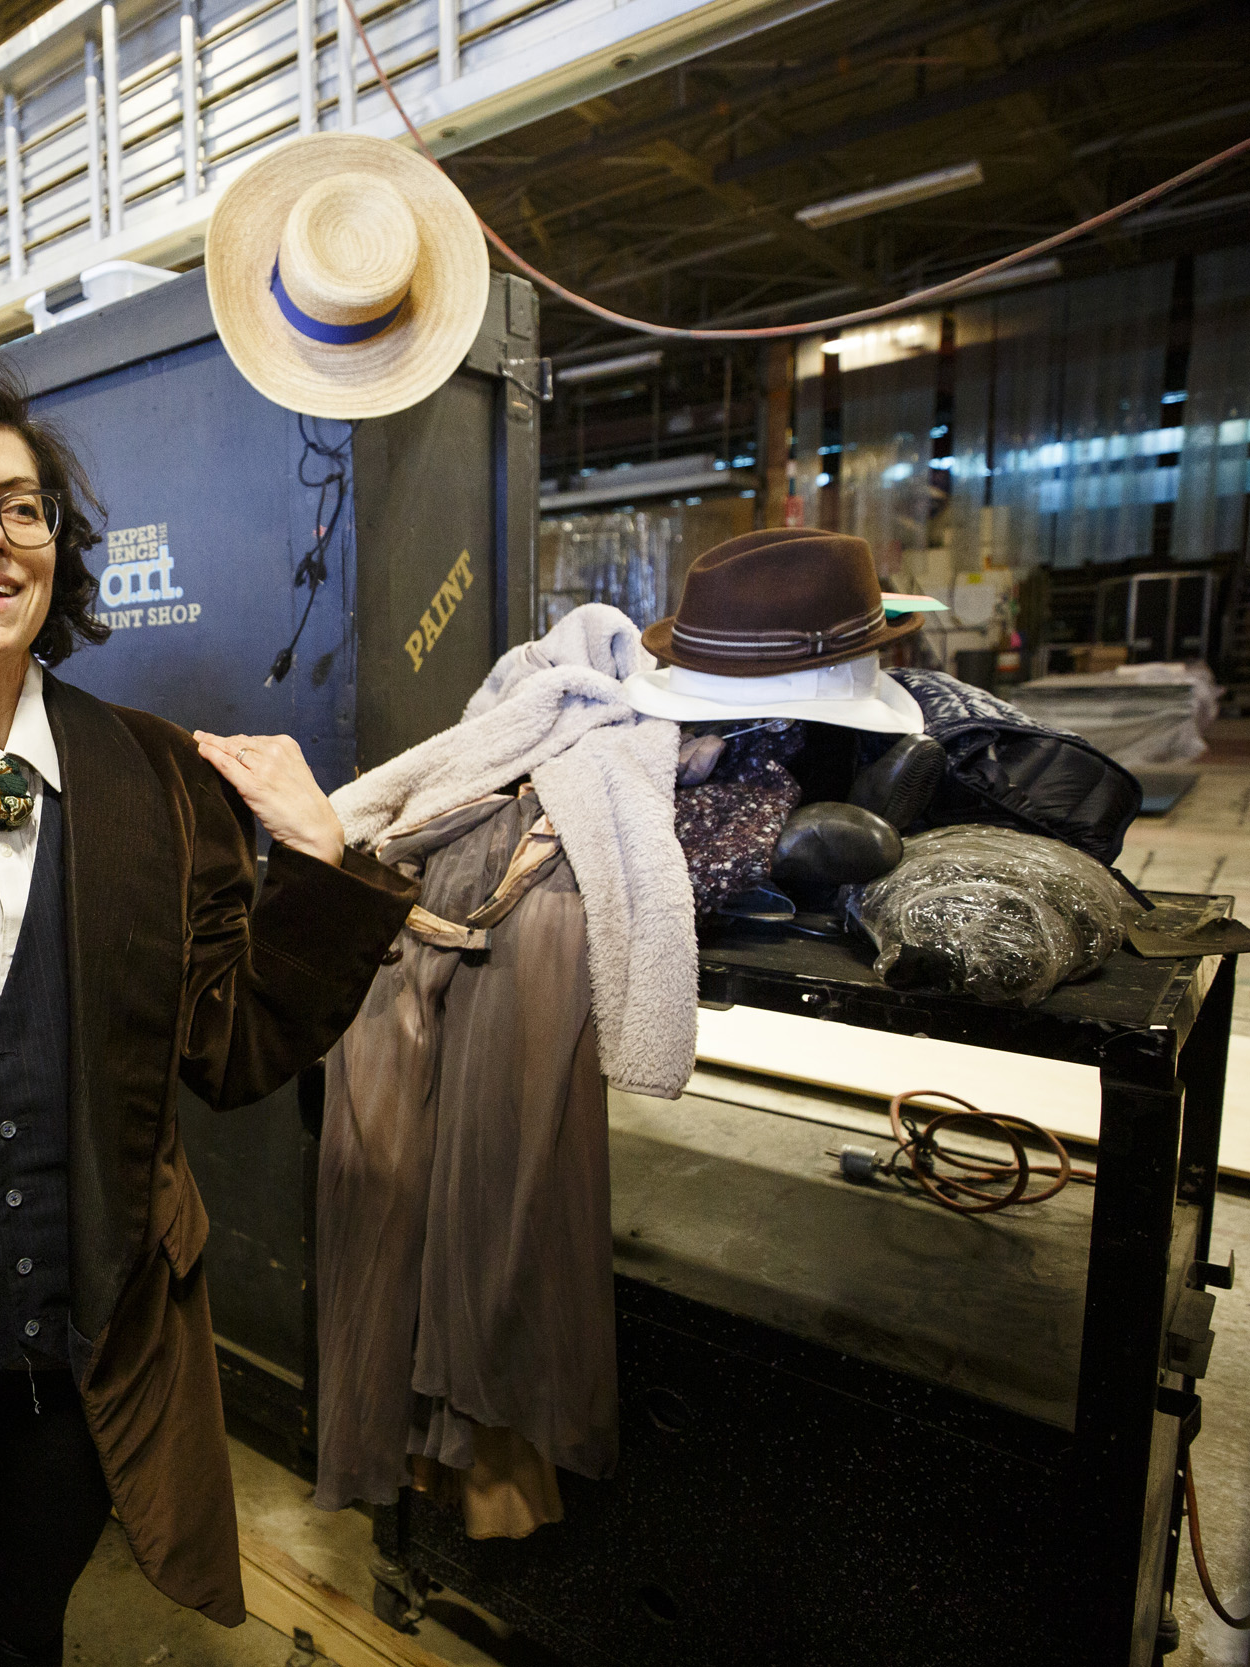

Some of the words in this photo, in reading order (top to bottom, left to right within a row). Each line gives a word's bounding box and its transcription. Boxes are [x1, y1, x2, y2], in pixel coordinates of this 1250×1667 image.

[107, 525, 158, 548] EXPER
[108, 541, 159, 564] IENCE
[93, 608, 144, 630] AINT
[147, 603, 201, 626] SHOP
[404, 548, 473, 672] PAINT
